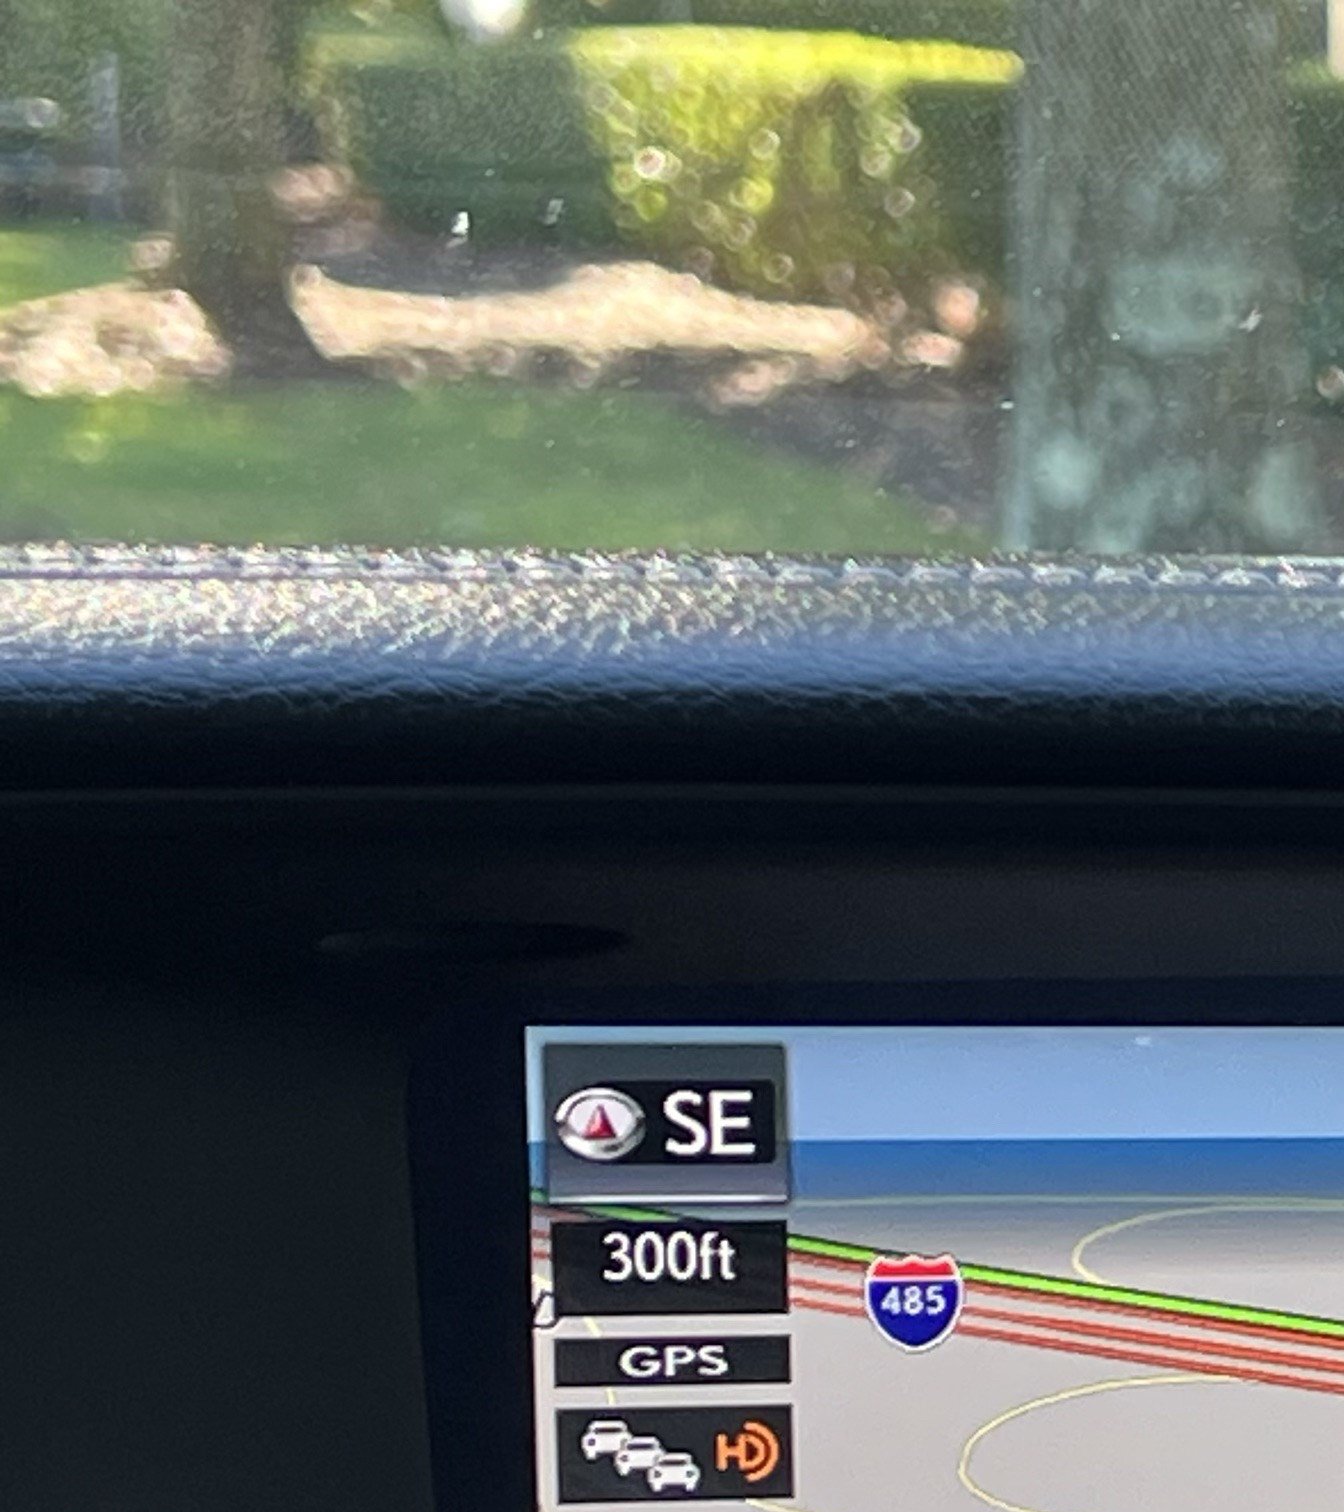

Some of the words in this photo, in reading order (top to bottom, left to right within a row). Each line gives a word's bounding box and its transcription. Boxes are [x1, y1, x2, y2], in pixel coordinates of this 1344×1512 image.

[663, 1090, 756, 1156] SE
[602, 1231, 736, 1282] 300ft
[880, 1286, 946, 1315] 485
[618, 1345, 729, 1377] GPS
